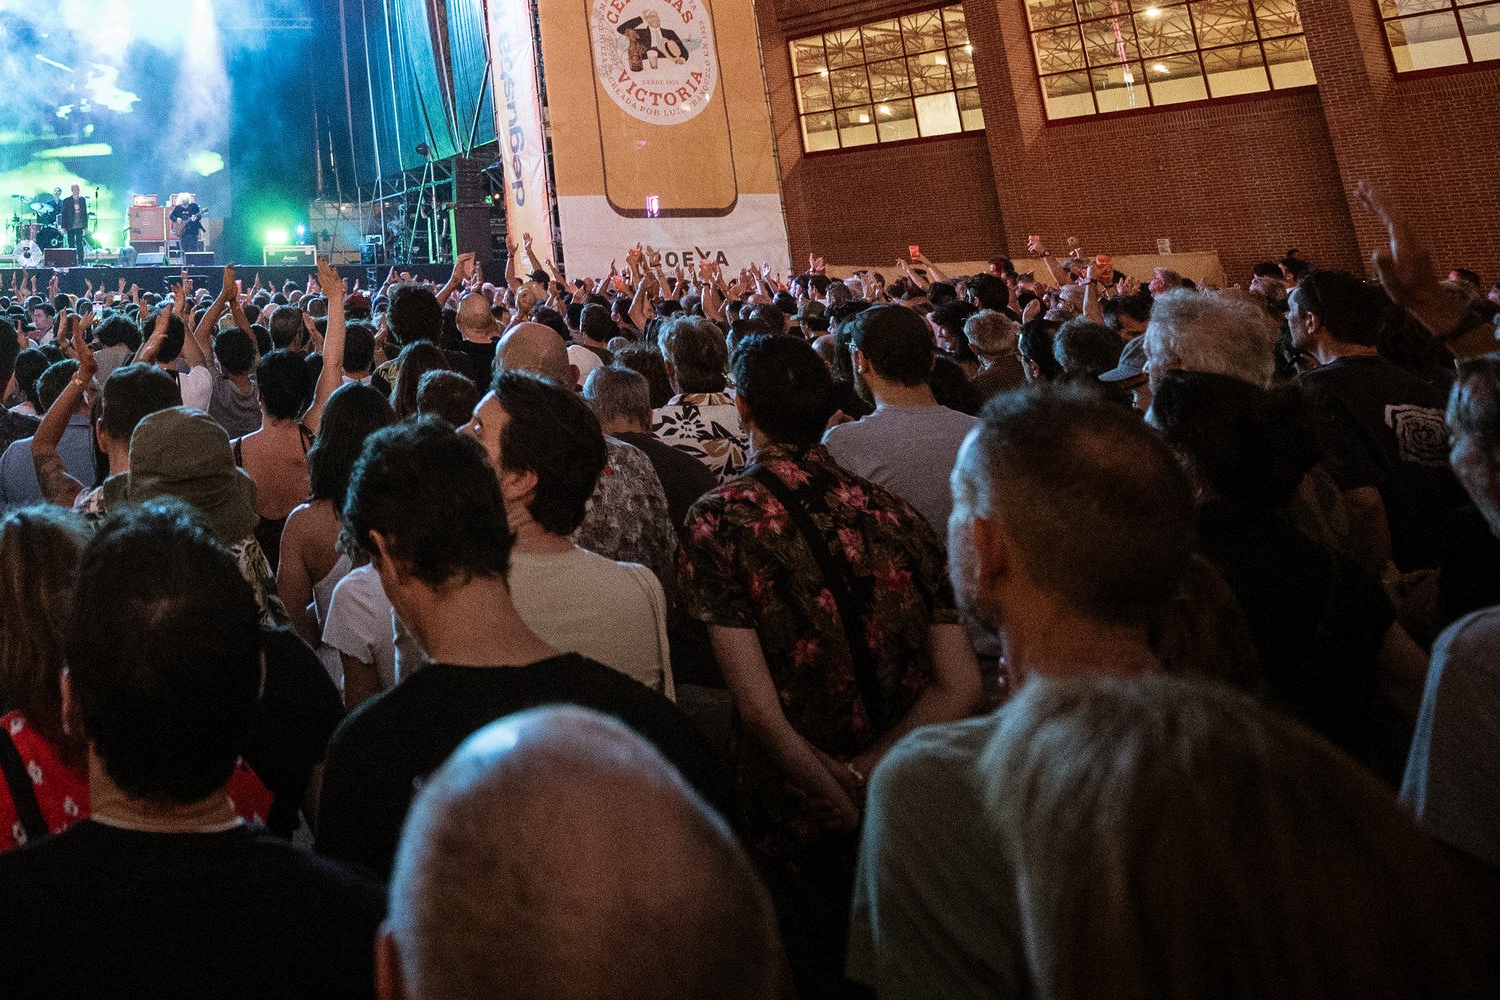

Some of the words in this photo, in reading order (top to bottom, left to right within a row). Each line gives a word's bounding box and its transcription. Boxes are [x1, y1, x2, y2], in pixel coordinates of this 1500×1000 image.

[617, 69, 703, 106] VICTORIA
[499, 31, 526, 207] degusta
[640, 105, 660, 116] POR
